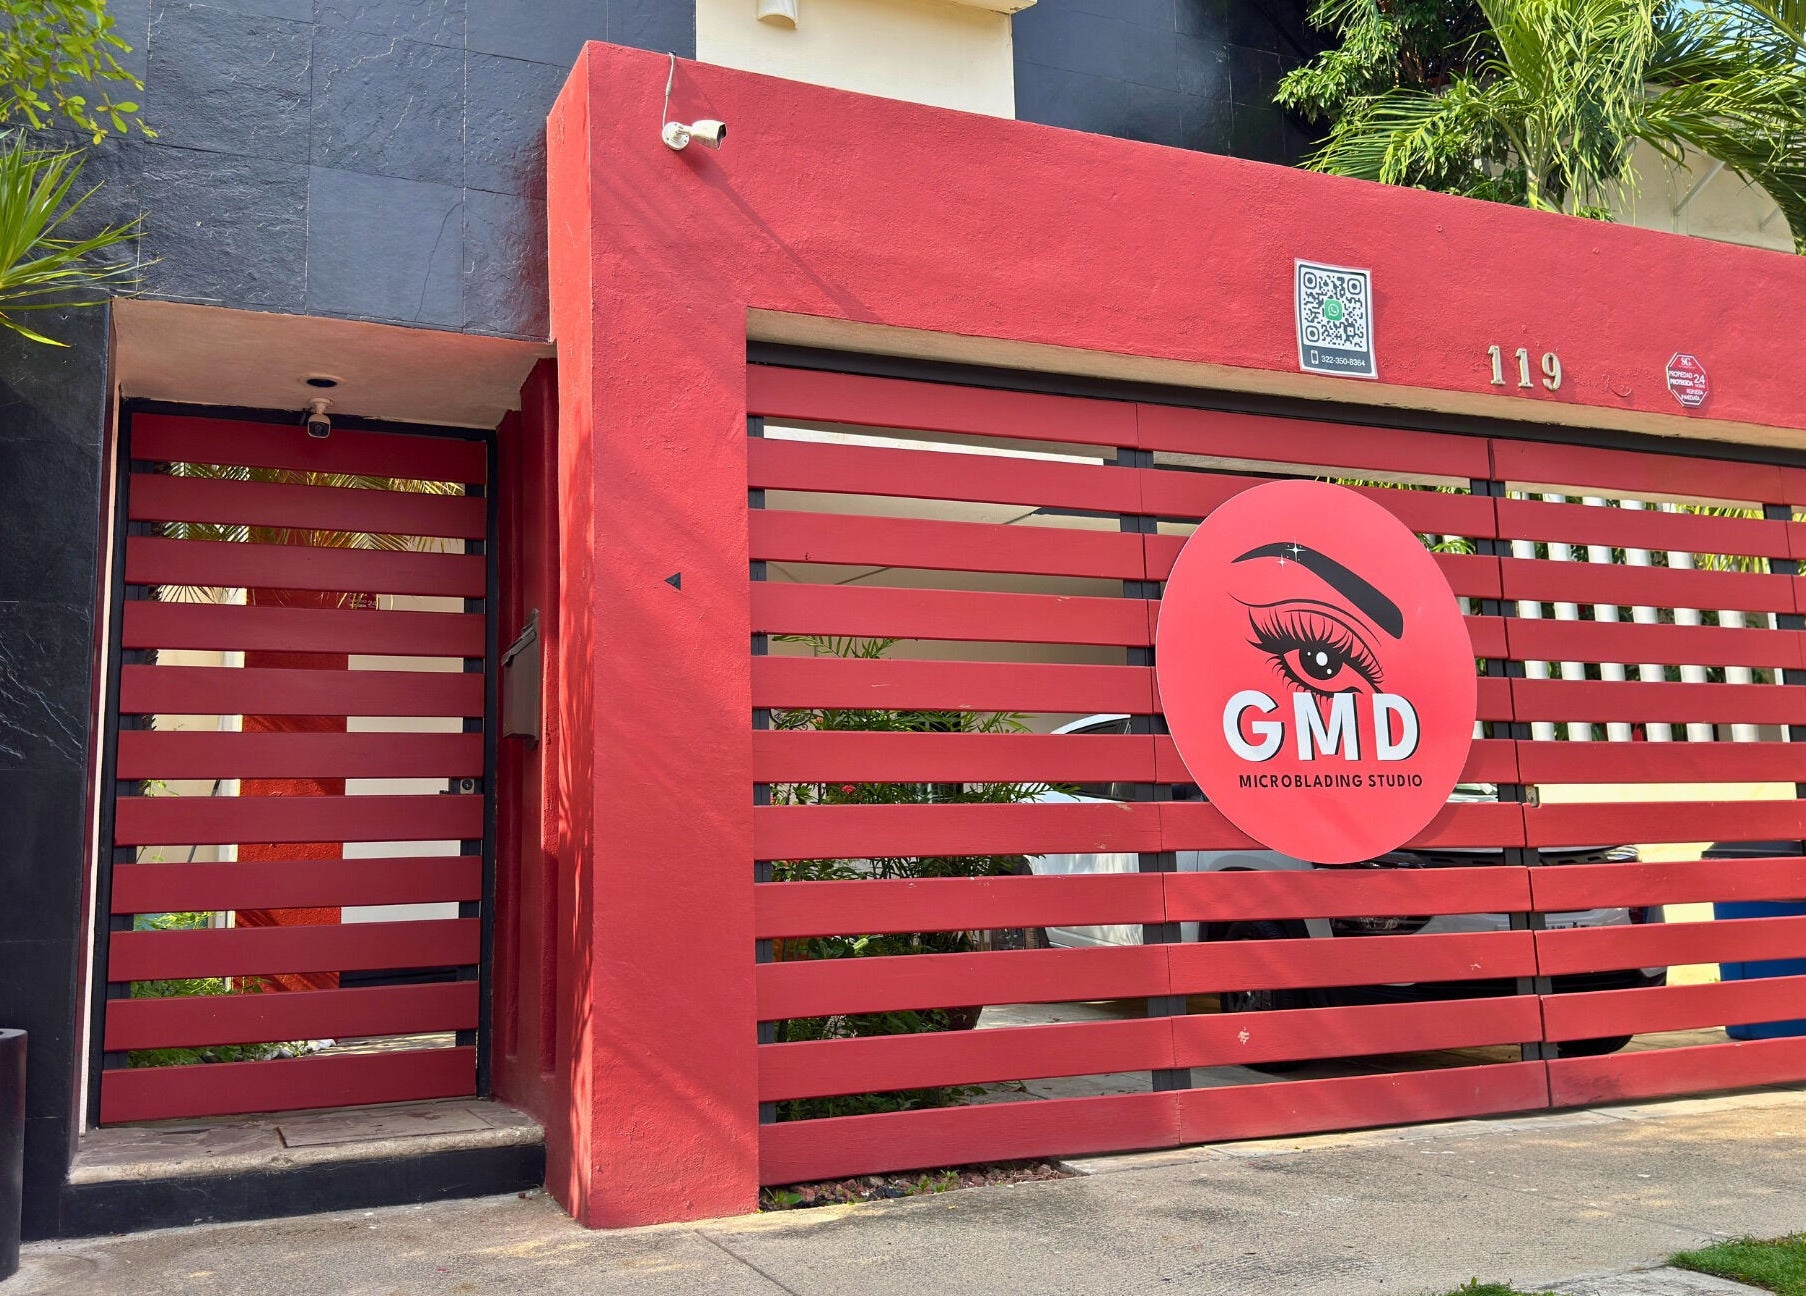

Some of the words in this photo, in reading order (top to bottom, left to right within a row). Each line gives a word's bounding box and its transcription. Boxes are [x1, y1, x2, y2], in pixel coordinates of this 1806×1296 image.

[1487, 345, 1562, 392] 119
[1693, 373, 1706, 385] 24
[1222, 689, 1421, 762] GMD
[1239, 774, 1363, 788] MICROBLADING
[1368, 774, 1423, 788] STUDIO
